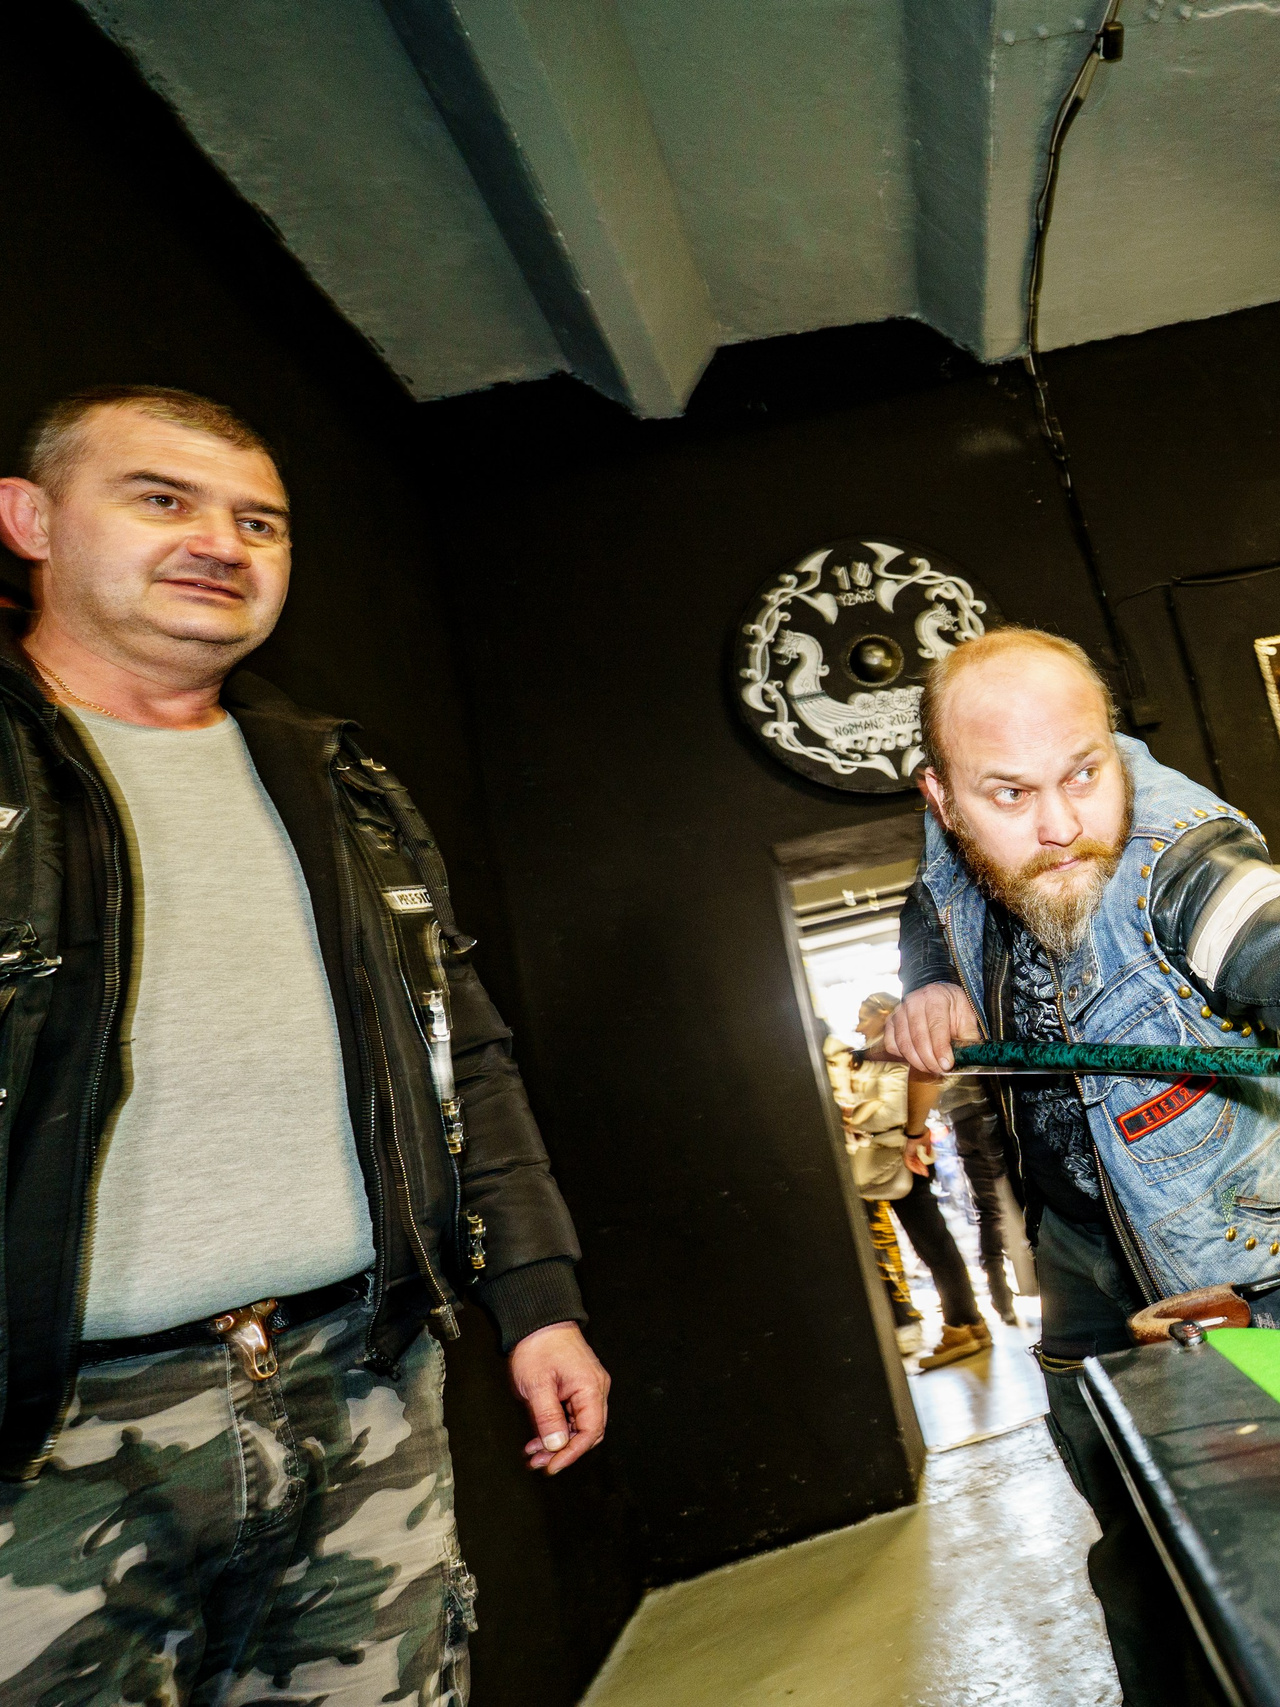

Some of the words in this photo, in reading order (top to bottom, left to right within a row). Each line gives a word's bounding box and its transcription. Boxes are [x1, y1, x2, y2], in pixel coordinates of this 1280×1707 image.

[837, 588, 876, 606] YEARS
[834, 716, 885, 737] NORMANS
[1142, 1087, 1193, 1124] ЕМЕЛЯ
